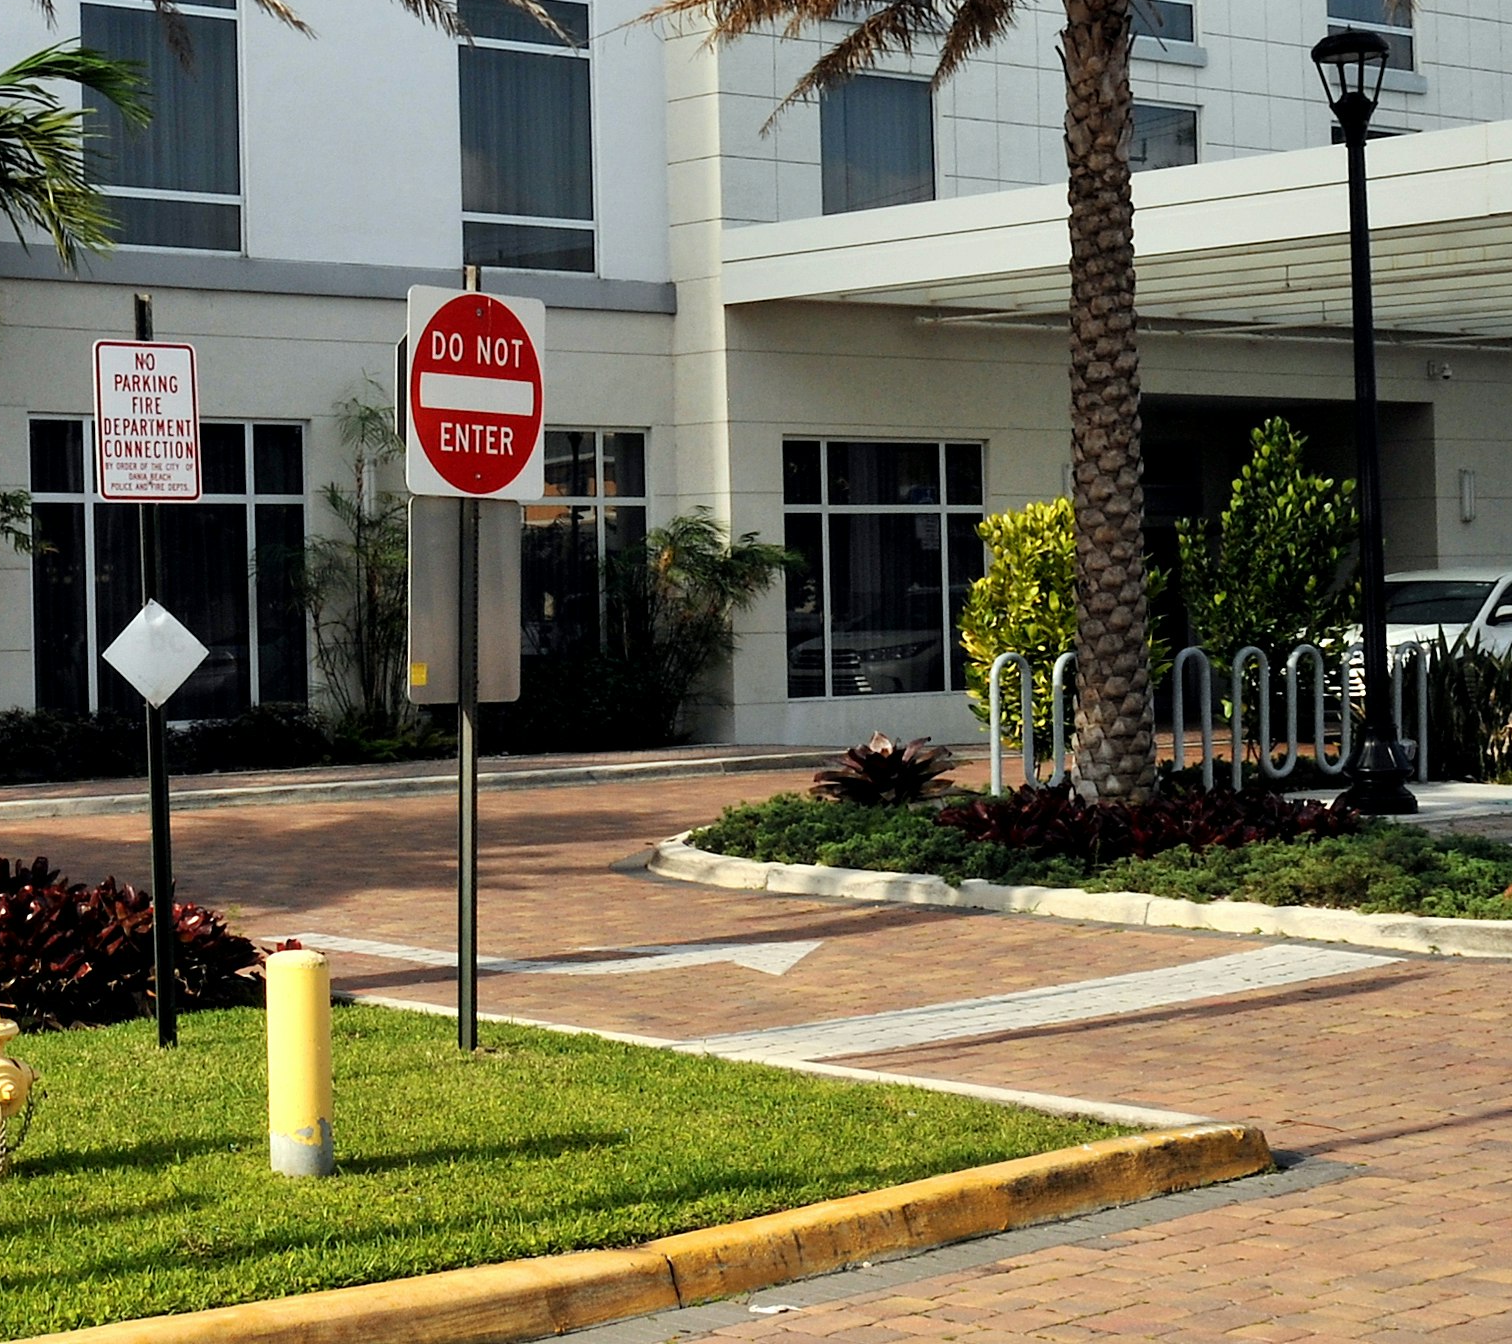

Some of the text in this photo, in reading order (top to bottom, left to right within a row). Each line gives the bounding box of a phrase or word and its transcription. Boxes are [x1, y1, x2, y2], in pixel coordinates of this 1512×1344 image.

[431, 330, 524, 368] DO NOT
[135, 352, 155, 371] NO
[114, 374, 178, 394] PARKING
[132, 396, 162, 415] FIRE
[104, 418, 192, 437] DEPARTMENT
[440, 421, 514, 456] ENTER
[104, 439, 194, 459] CONNECTION
[116, 462, 137, 471] ORDER
[140, 463, 148, 471] OF
[151, 463, 163, 471] THE
[166, 463, 179, 471] CITY
[111, 482, 132, 491] POLICE
[136, 482, 148, 491] AND
[151, 483, 165, 491] FIRE
[128, 473, 172, 481] DANIA BEACH
